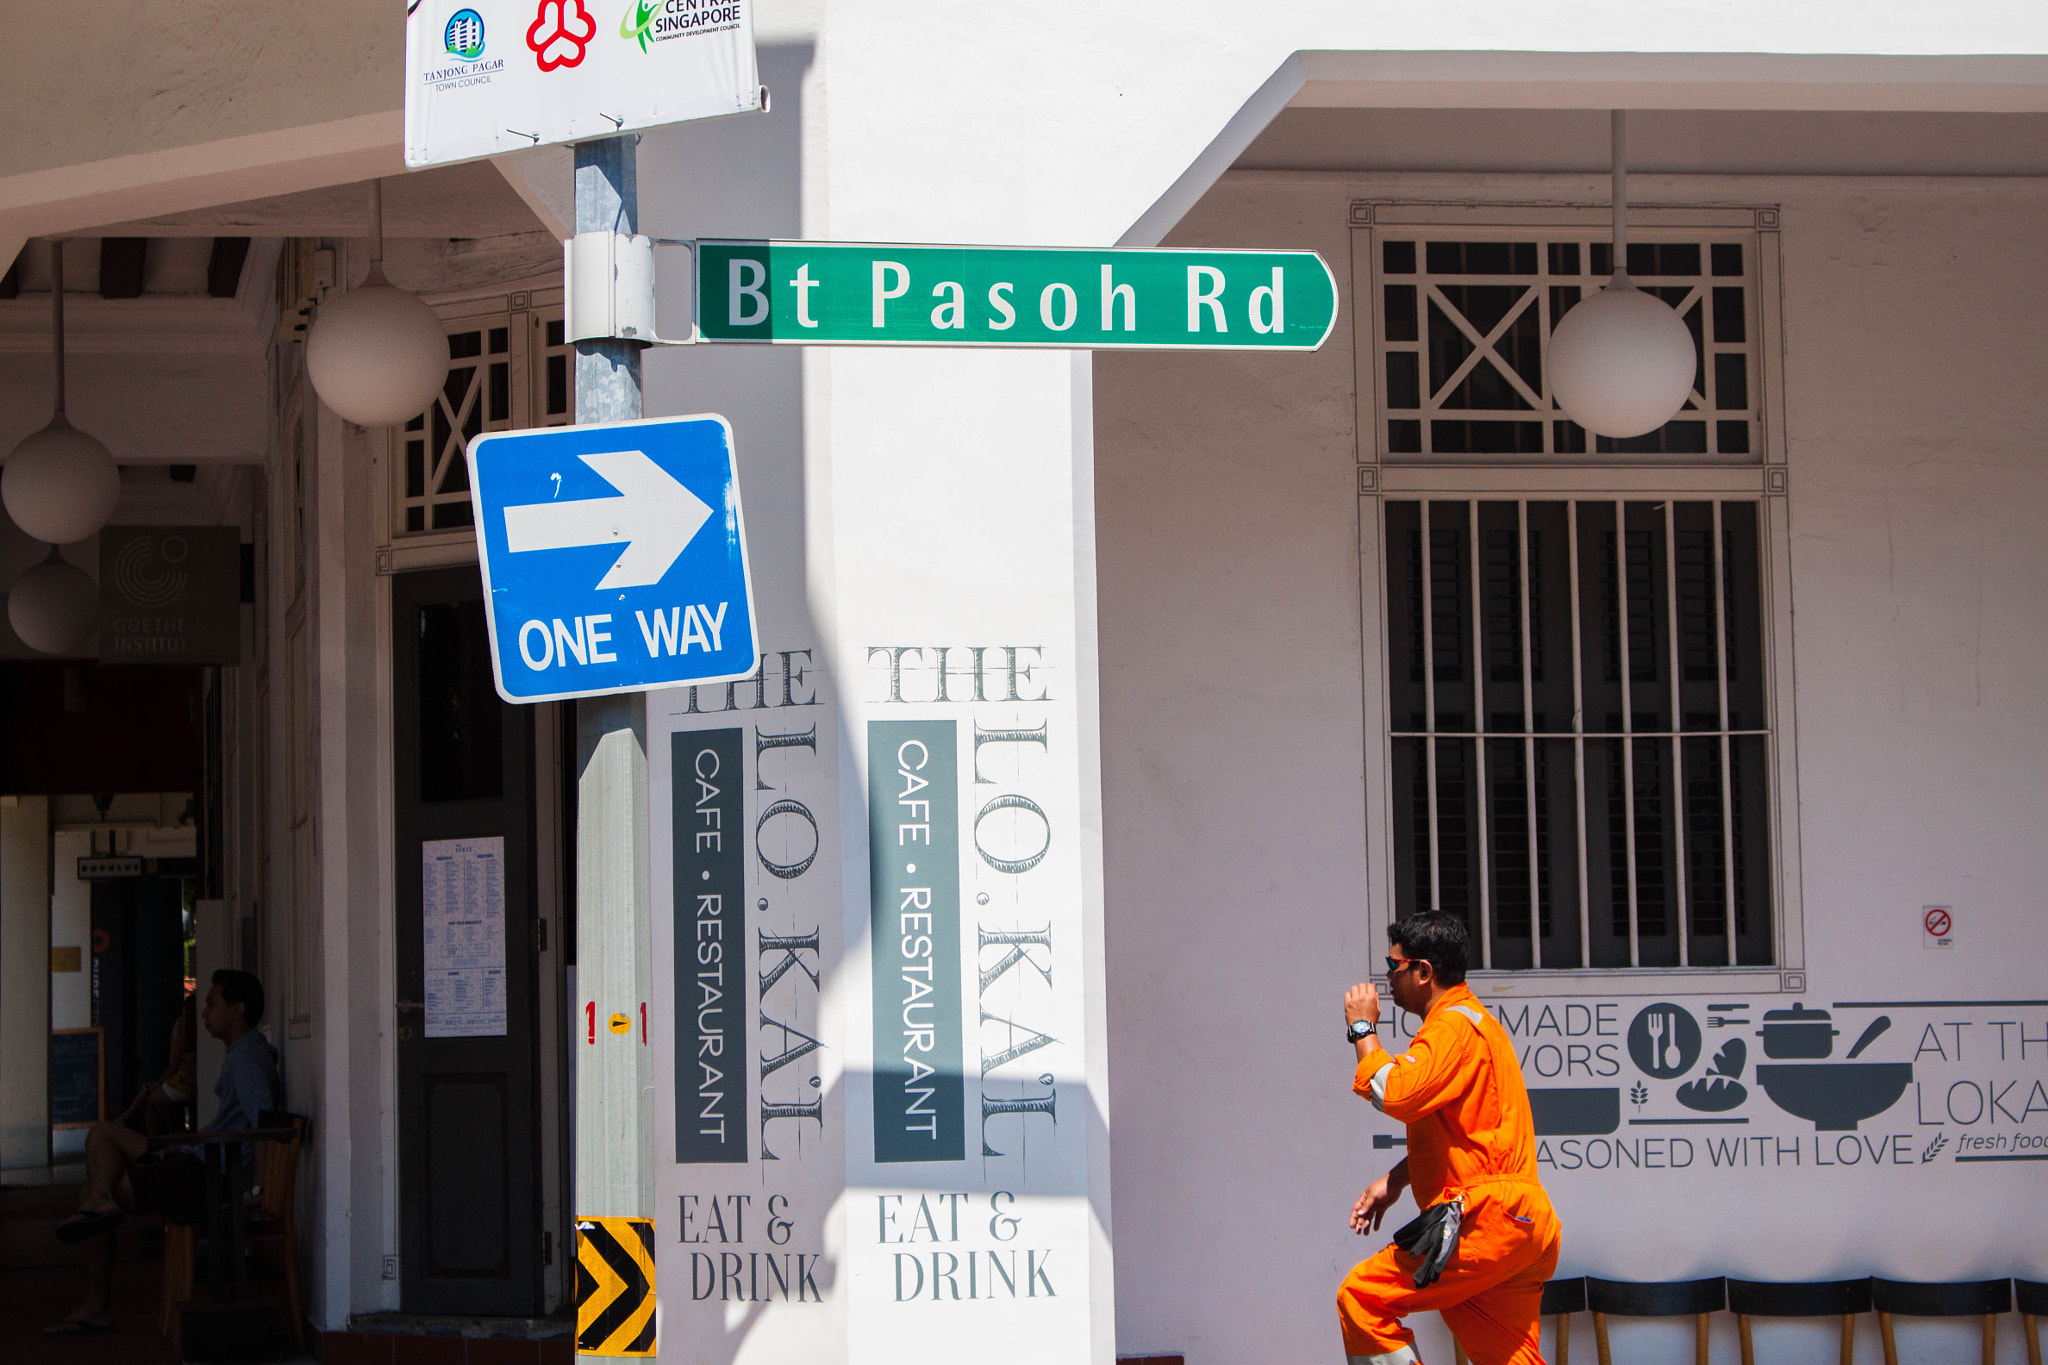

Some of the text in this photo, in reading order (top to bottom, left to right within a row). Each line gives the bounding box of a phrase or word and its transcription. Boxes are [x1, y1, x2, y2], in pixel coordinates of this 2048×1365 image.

[655, 5, 741, 33] SINGAPORE
[655, 23, 741, 42] COMMUNITY DEVELOPMENT COUNCIL
[423, 59, 504, 82] TANJONG PAGAR
[435, 75, 492, 92] TOWN COUNCIL
[728, 257, 1286, 336] Bt Pasoh Rd
[114, 617, 187, 633] GOETHE
[114, 636, 187, 652] INSTITUT
[518, 601, 729, 671] ONE WAY
[867, 645, 1048, 702] THE
[694, 748, 726, 1144] CAFE RESTAURANT
[897, 739, 937, 1140] CAFE RESTAURANT
[1914, 1021, 1973, 1062] AT
[1536, 1134, 1914, 1169] ASONED WITH LOVE
[1955, 1132, 2008, 1153] fresh
[677, 1193, 795, 1245] EAT &
[875, 1190, 1023, 1244] EAT &
[690, 1251, 825, 1304] DRINK
[893, 1248, 1059, 1302] DRINK
